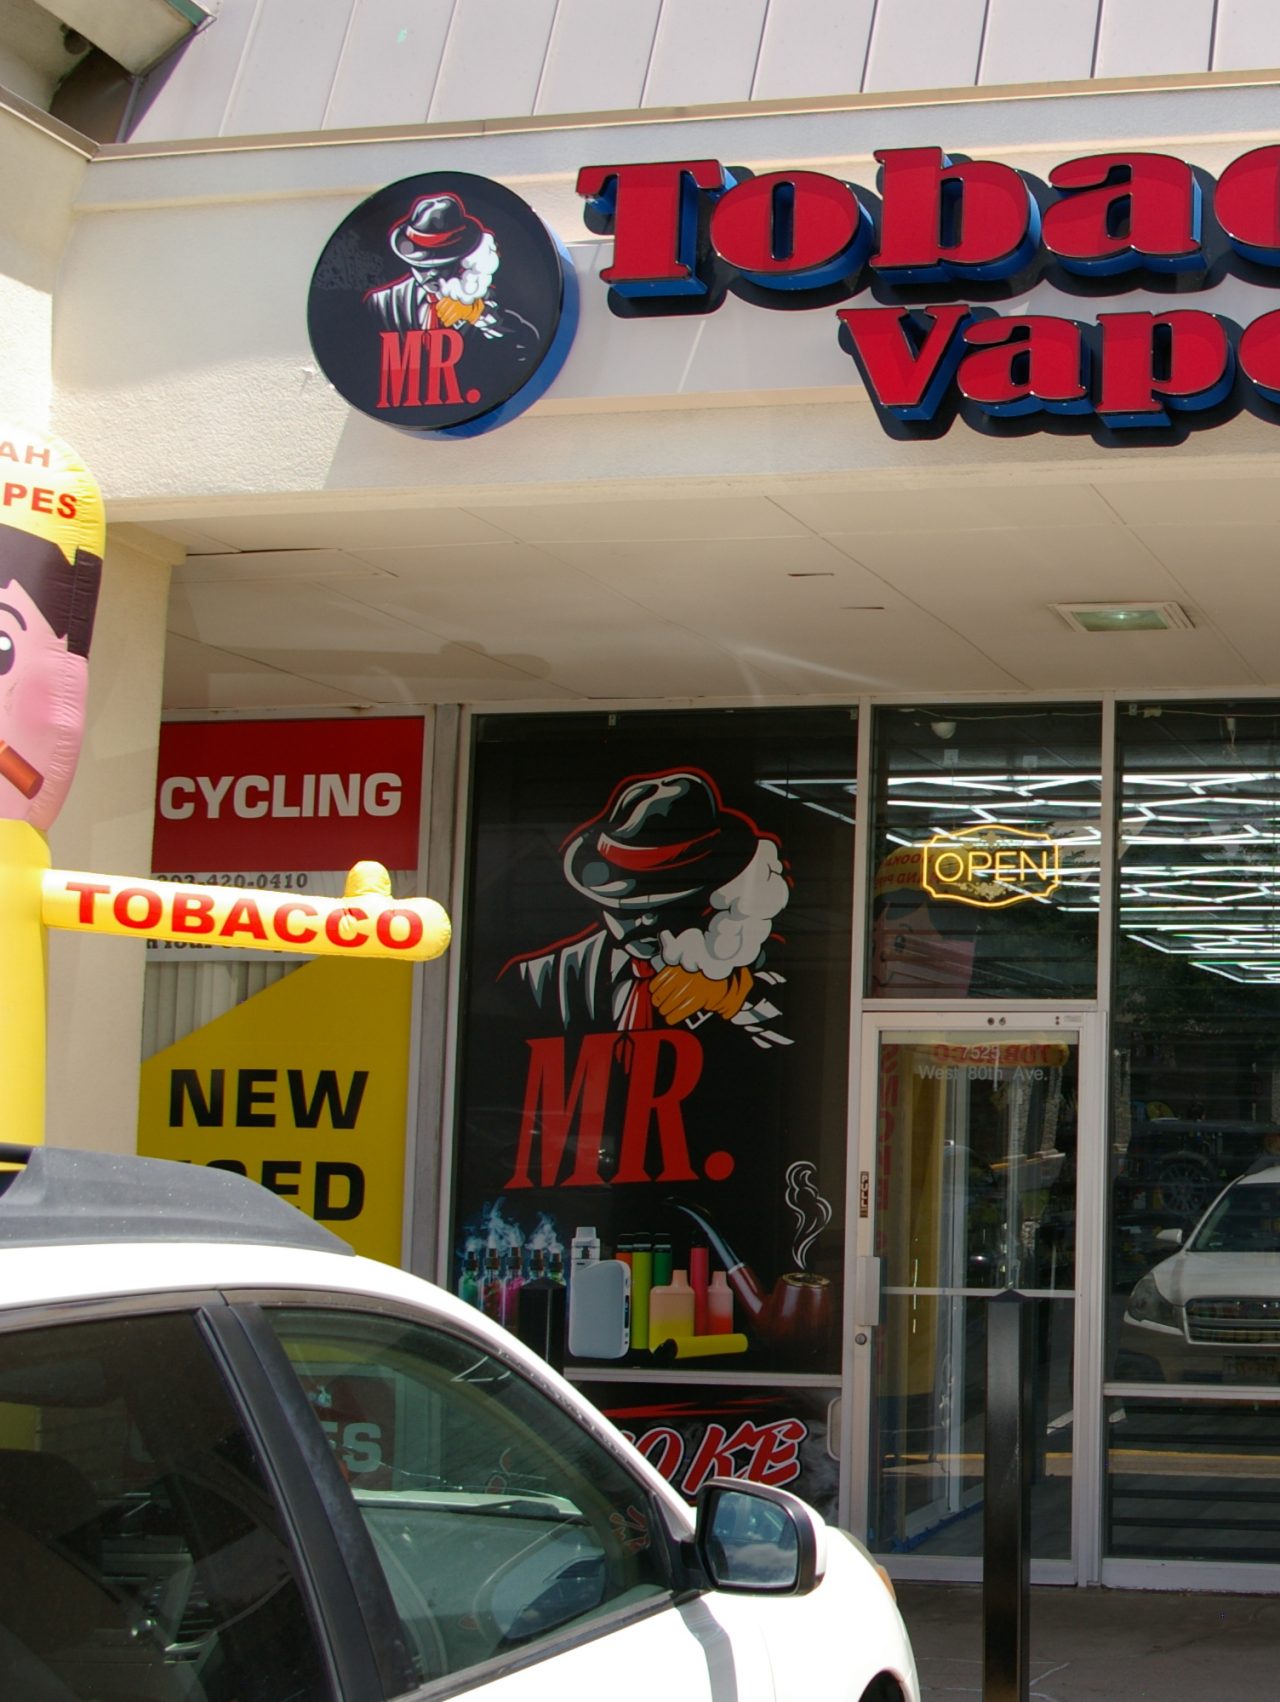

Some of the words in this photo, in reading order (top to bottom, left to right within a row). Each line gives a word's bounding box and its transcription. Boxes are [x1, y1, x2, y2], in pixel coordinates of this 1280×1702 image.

[376, 330, 481, 408] MR.
[0, 441, 50, 468] AH
[3, 482, 77, 519] PES
[160, 772, 402, 820] CYCLING
[935, 850, 1048, 882] OPEN
[66, 881, 424, 950] TOBACCO
[919, 1065, 959, 1081] West
[968, 1065, 1003, 1081] 80th
[1012, 1065, 1048, 1081] Ave.
[169, 1069, 370, 1129] NEW
[504, 1029, 735, 1190] MR.
[175, 1159, 366, 1222] ED
[860, 1174, 869, 1209] PULL
